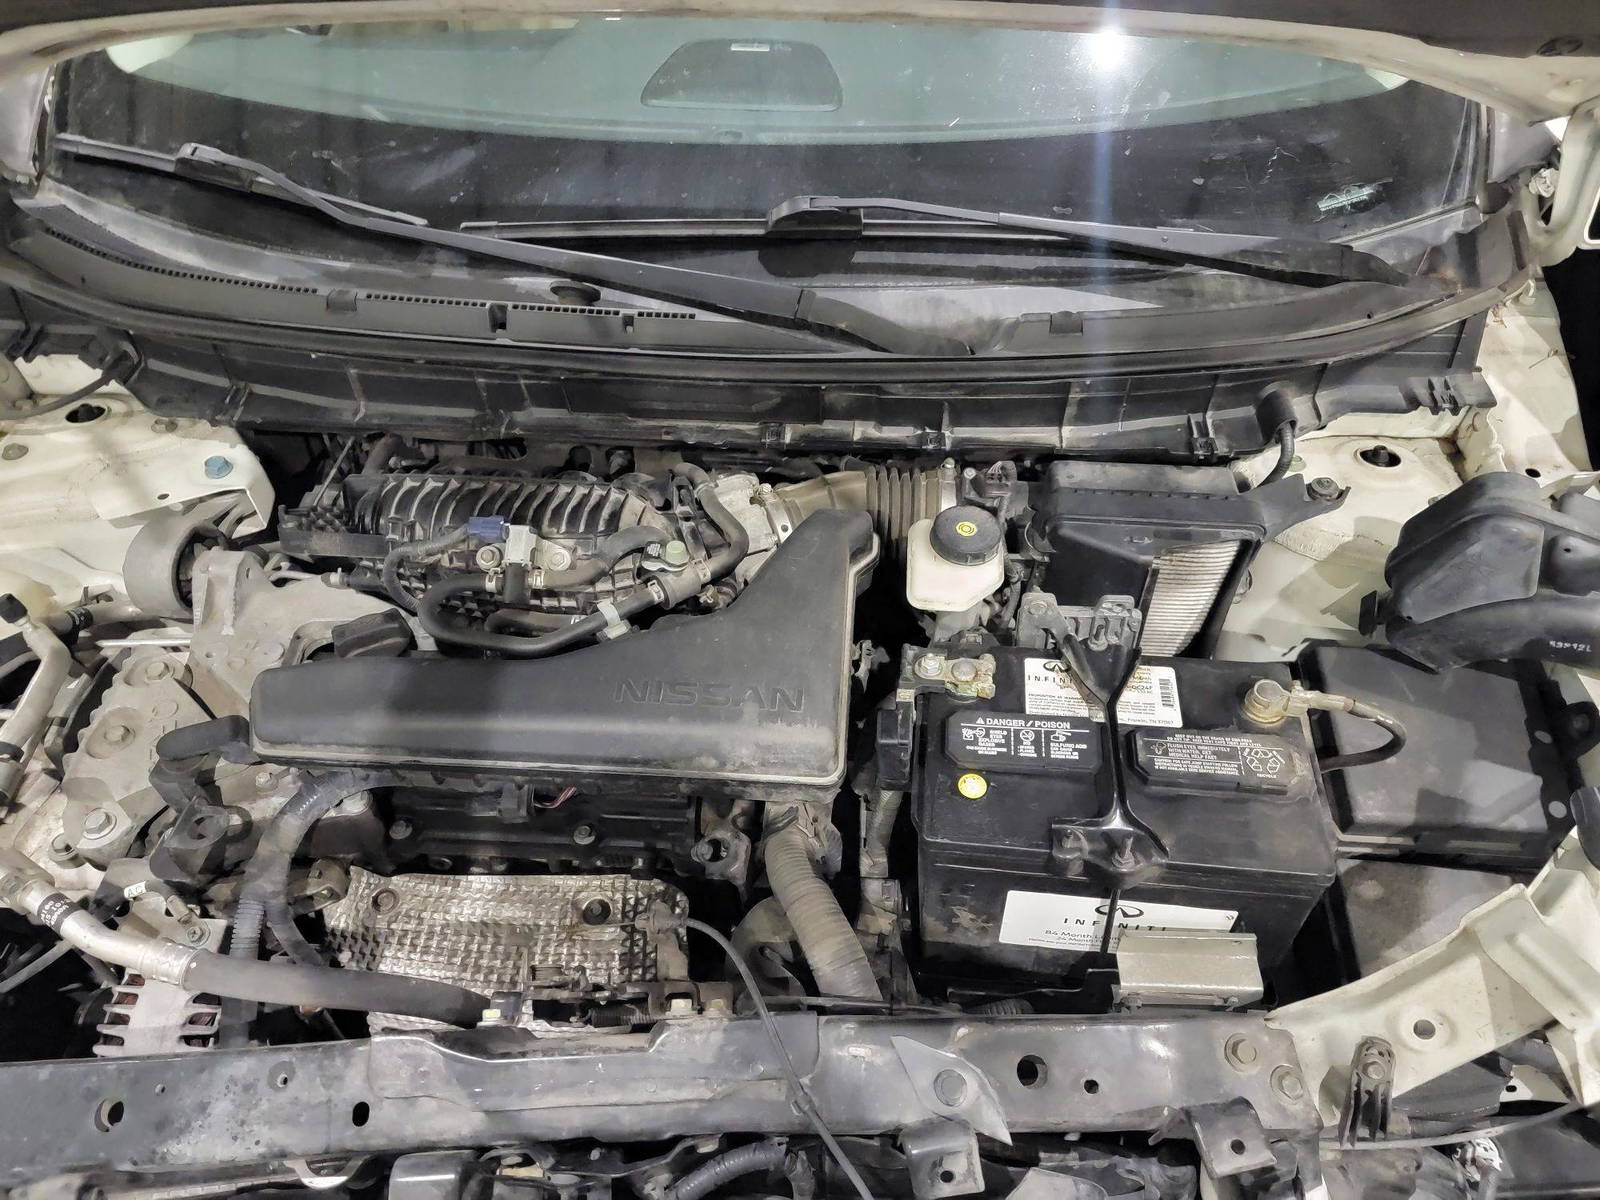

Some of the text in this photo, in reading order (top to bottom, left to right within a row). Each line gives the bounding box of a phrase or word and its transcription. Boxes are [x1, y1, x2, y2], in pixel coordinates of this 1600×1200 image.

[1027, 674, 1073, 684] INFINI
[613, 679, 805, 713] NISSAN
[986, 717, 1025, 727] DANGER
[1035, 720, 1071, 729] POISON
[1064, 917, 1167, 932] INFNITI
[1060, 931, 1093, 939] Month
